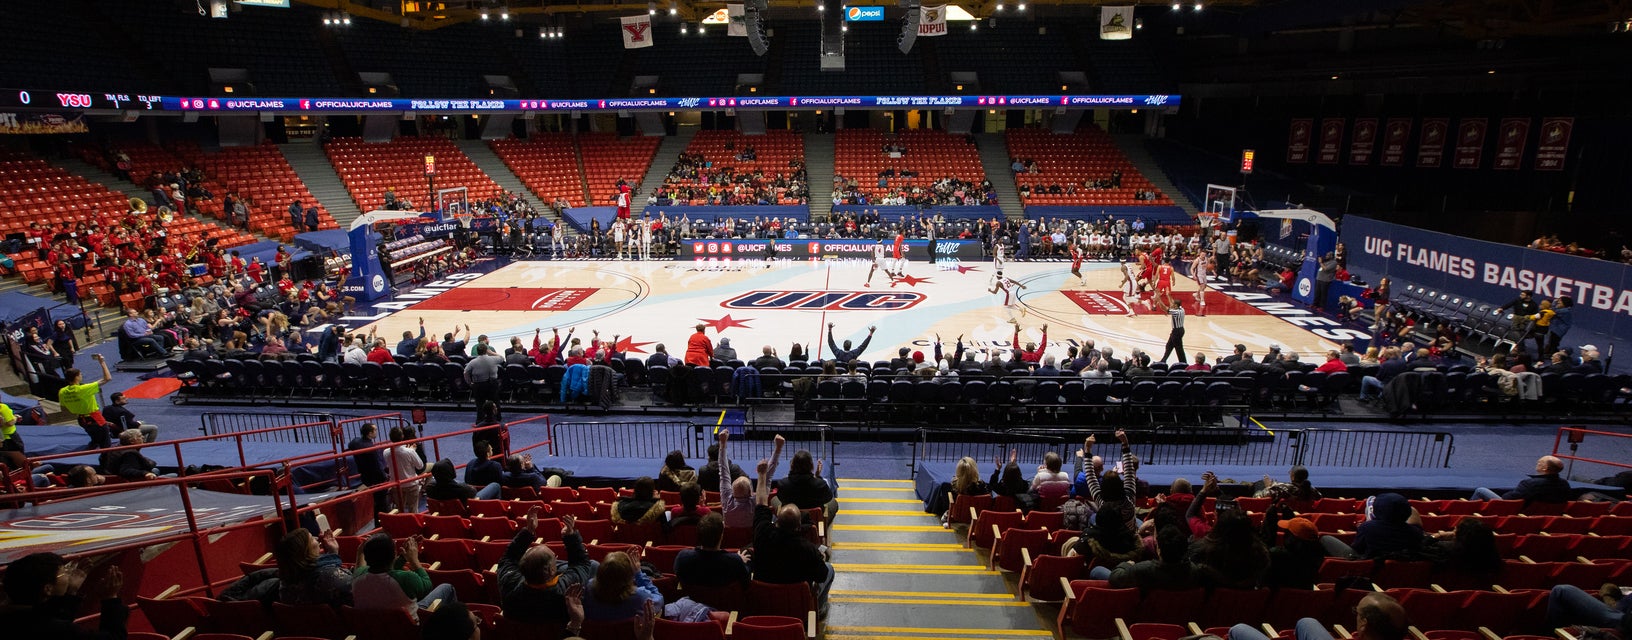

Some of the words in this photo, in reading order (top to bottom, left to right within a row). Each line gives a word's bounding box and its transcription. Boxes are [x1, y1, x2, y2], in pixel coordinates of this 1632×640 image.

[861, 9, 881, 18] pepsi
[623, 21, 650, 42] Y
[919, 22, 945, 34] IUPUI
[20, 90, 31, 104] 0
[57, 93, 92, 108] YSU
[876, 97, 910, 105] FOLLOW
[910, 97, 928, 105] THE
[928, 97, 962, 105] FLAMES
[226, 100, 284, 108] @UICFLAMES
[411, 100, 449, 109] FOLLOW
[450, 101, 470, 109] THE
[470, 101, 505, 109] FLAMES
[738, 244, 792, 252] @UICFMES
[824, 244, 910, 252] OFFICIALUICAS
[1364, 236, 1392, 258] UIC
[1396, 243, 1476, 280] FLAMES
[1483, 262, 1632, 317] BASKETBA
[727, 291, 920, 309] UIC
